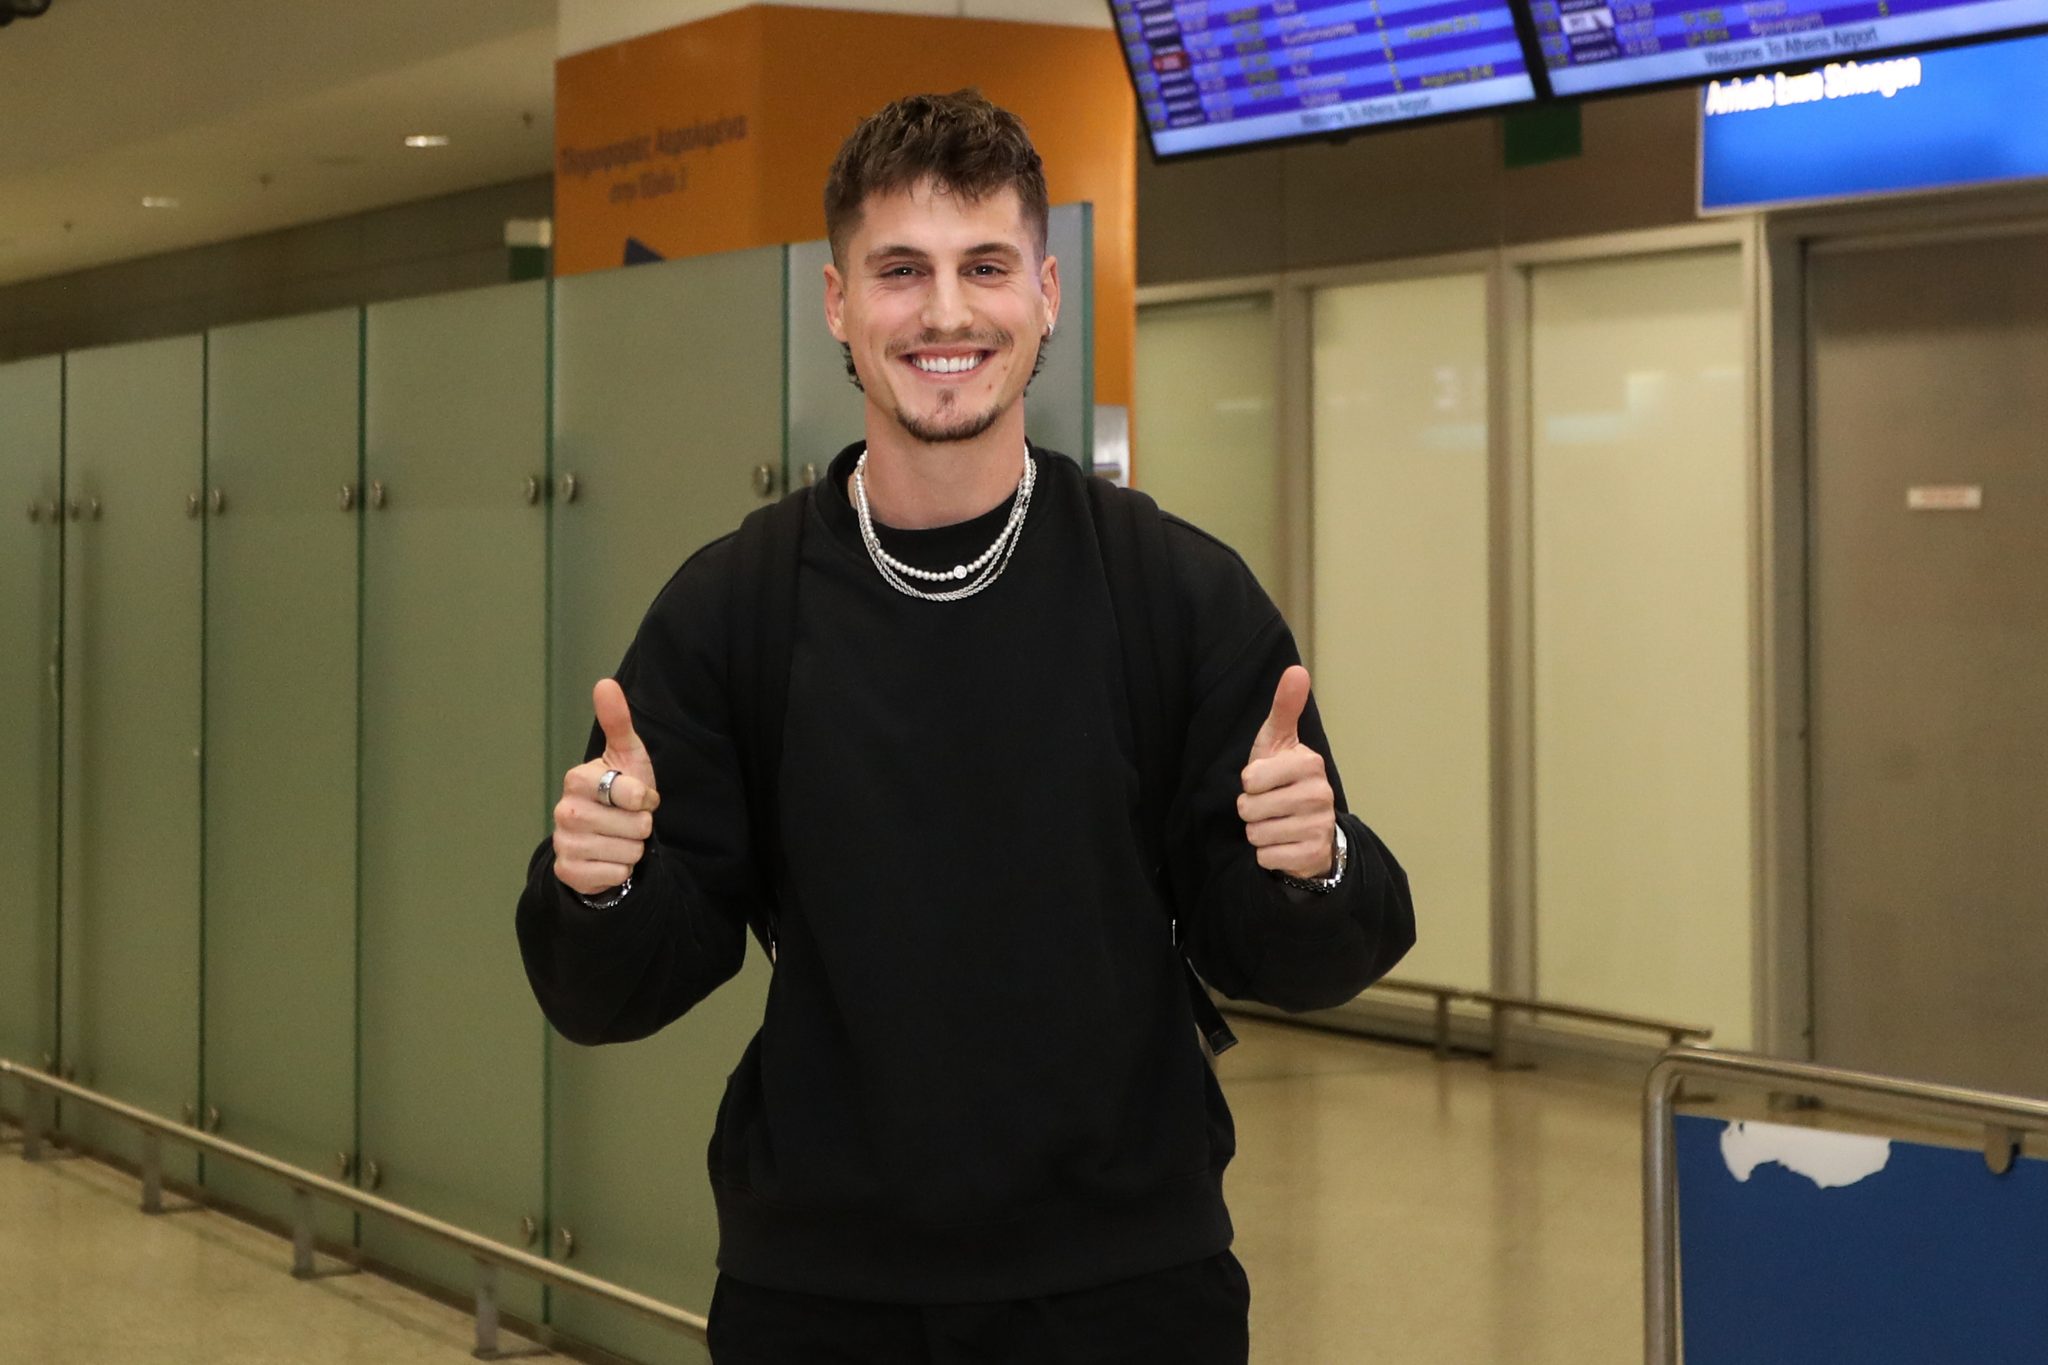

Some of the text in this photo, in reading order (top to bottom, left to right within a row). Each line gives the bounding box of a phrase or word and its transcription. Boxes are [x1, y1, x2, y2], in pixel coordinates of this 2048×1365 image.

[1704, 26, 1878, 67] Welcome To Athens Airport
